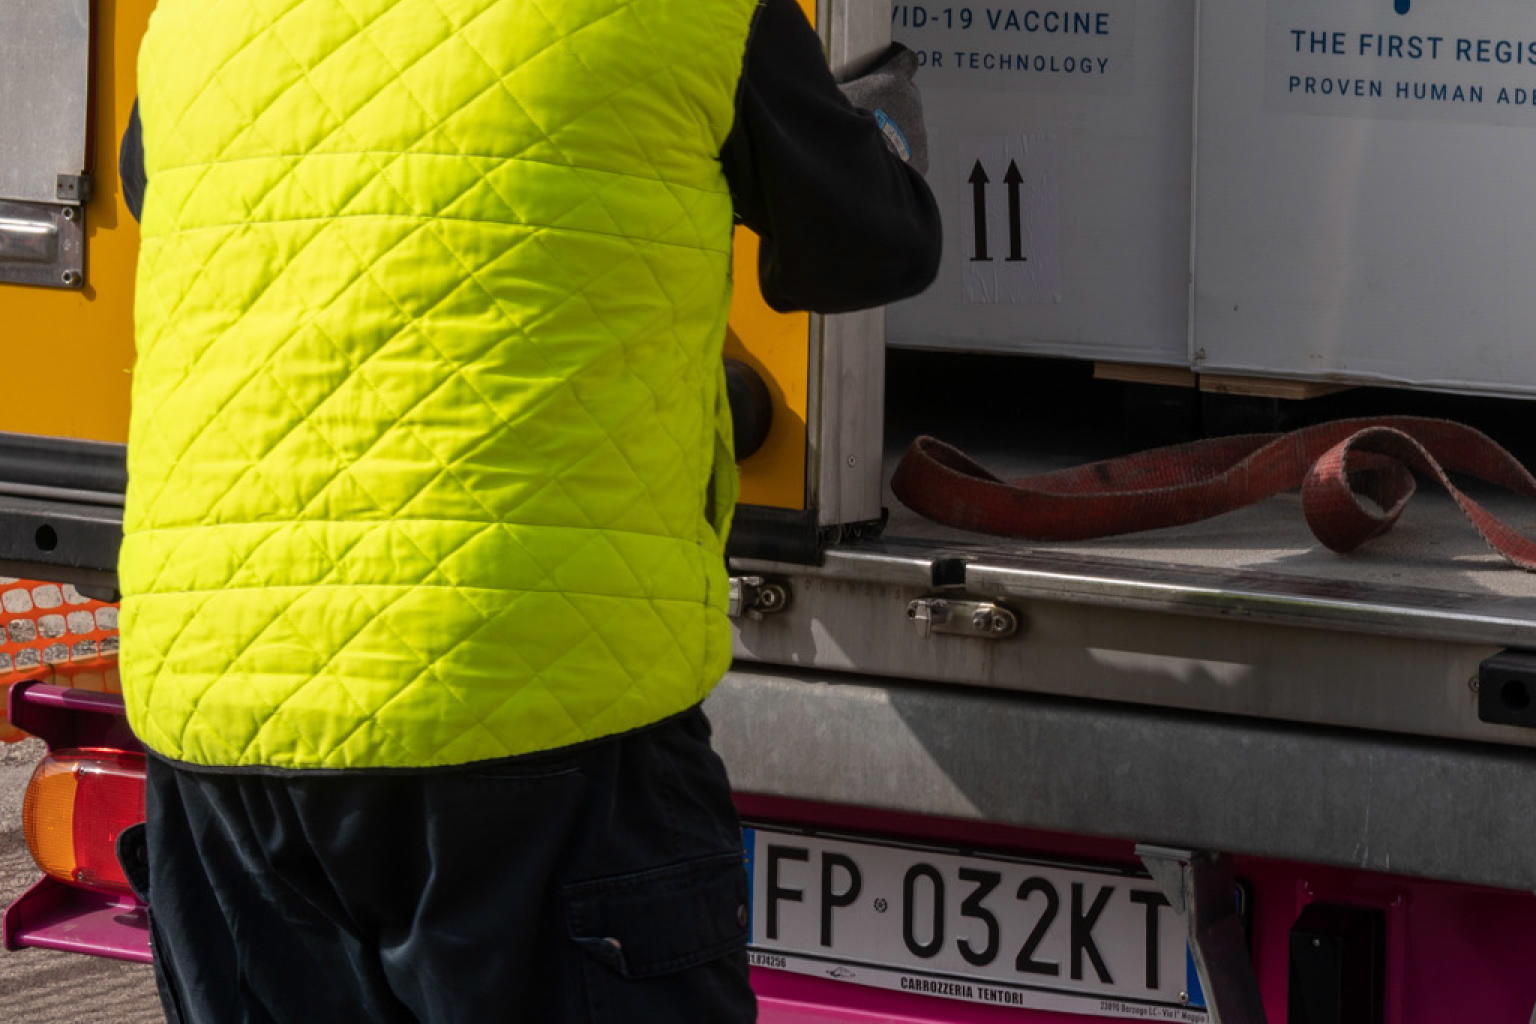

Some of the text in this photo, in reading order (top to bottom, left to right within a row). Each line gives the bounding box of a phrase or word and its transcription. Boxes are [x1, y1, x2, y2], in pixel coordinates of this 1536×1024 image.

[987, 10, 1108, 34] VACCINE
[1291, 30, 1345, 54] THE
[1360, 34, 1443, 59] FIRST
[956, 52, 1108, 73] TECHNOLOGY
[1290, 76, 1381, 96] PROVEN
[1397, 83, 1482, 102] HUMAN
[766, 844, 1173, 991] FP 032KT
[900, 977, 1023, 1006] CARROZZERIA TENTORI
